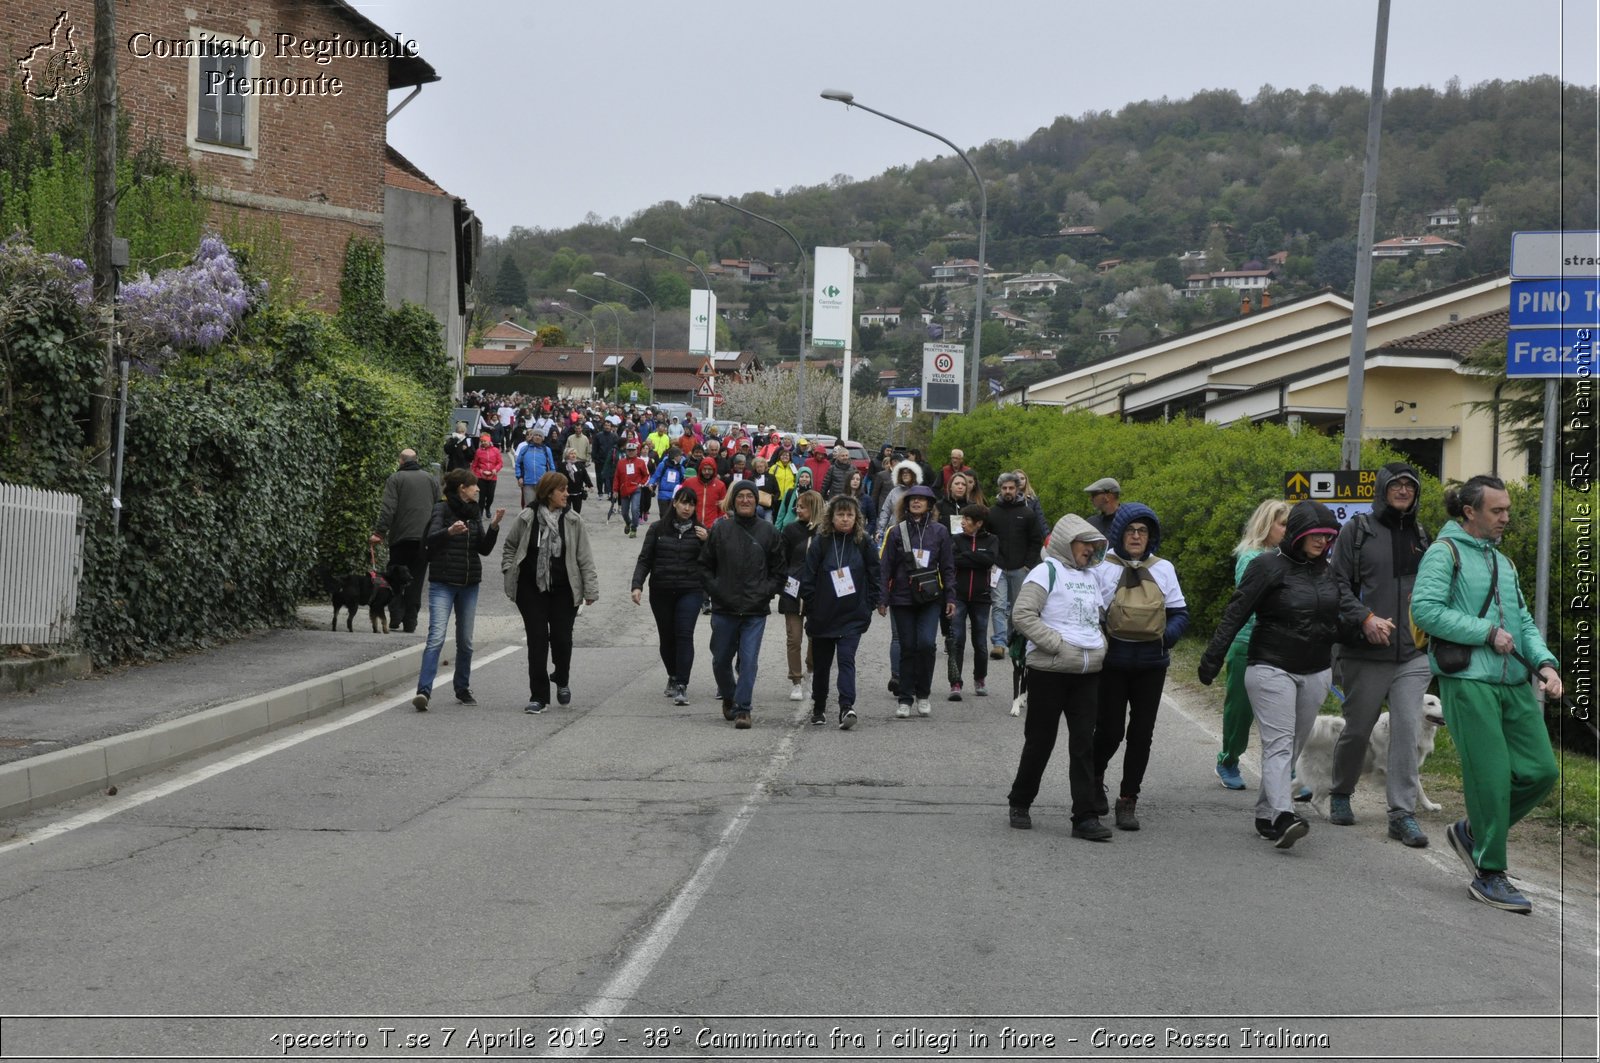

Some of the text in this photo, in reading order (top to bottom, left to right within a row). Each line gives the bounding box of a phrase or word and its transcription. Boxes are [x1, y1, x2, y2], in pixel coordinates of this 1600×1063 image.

[1518, 290, 1600, 312] PINO T
[1514, 342, 1577, 363] Fraz.
[938, 358, 949, 368] 50
[1337, 485, 1352, 497] LA
